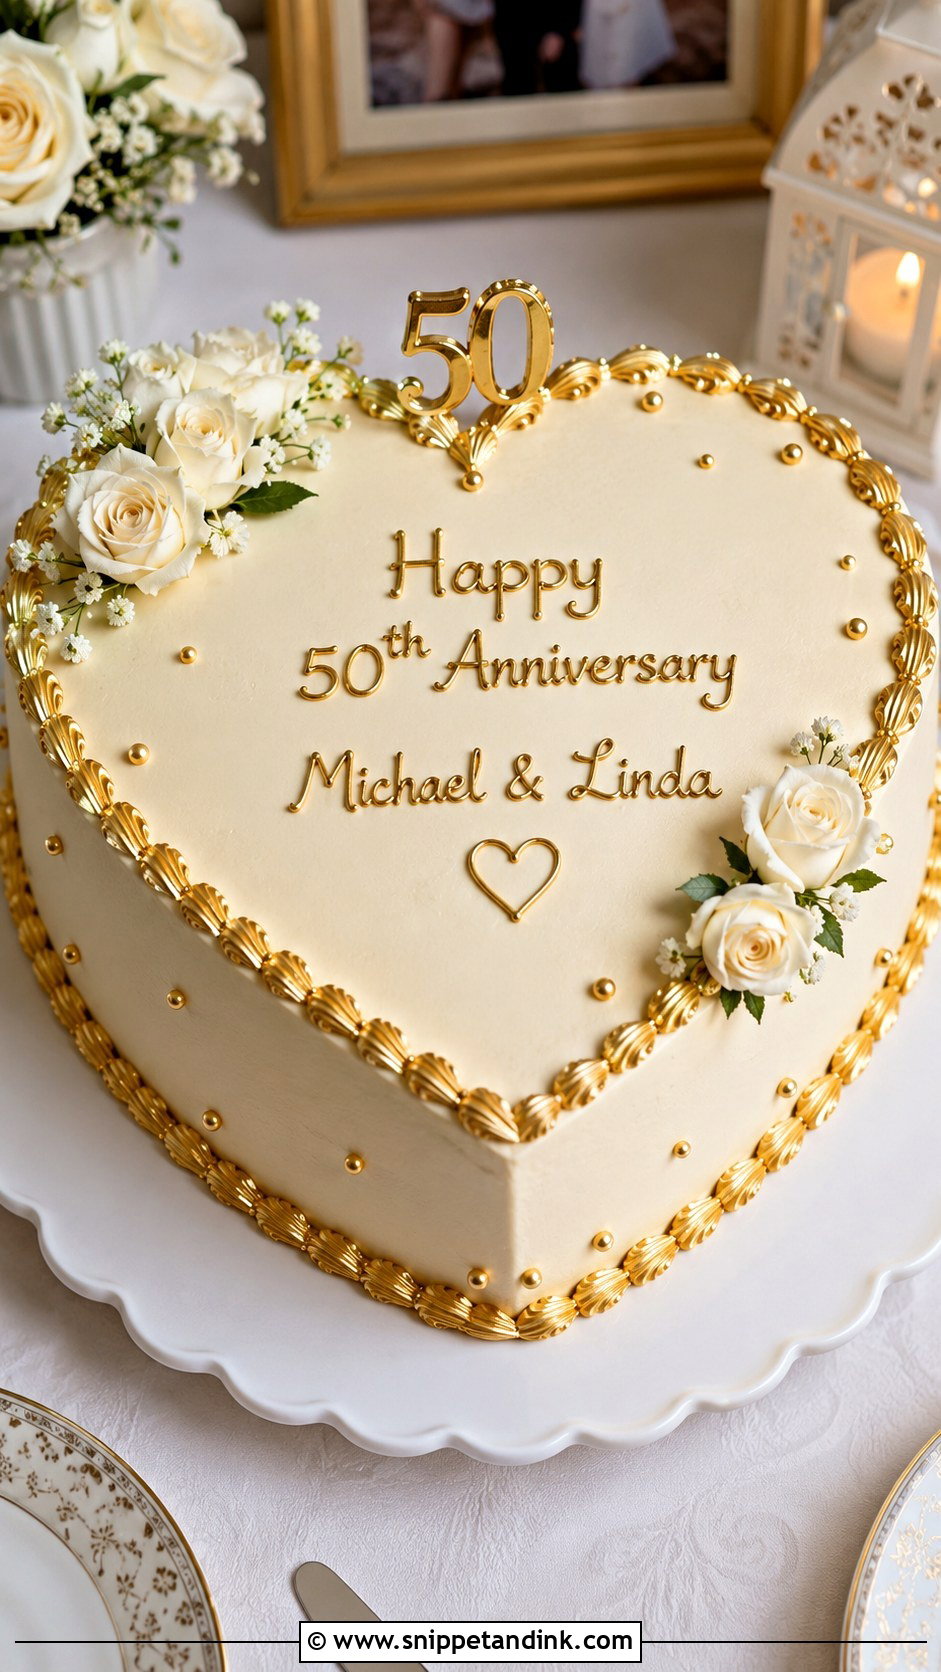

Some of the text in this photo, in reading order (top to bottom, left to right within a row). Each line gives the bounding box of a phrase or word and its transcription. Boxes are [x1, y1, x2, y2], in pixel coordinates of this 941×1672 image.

[397, 279, 554, 416] 50
[389, 527, 603, 621] Happy
[297, 621, 737, 711] 50th Anniversary
[286, 737, 723, 812] Michael & Linda
